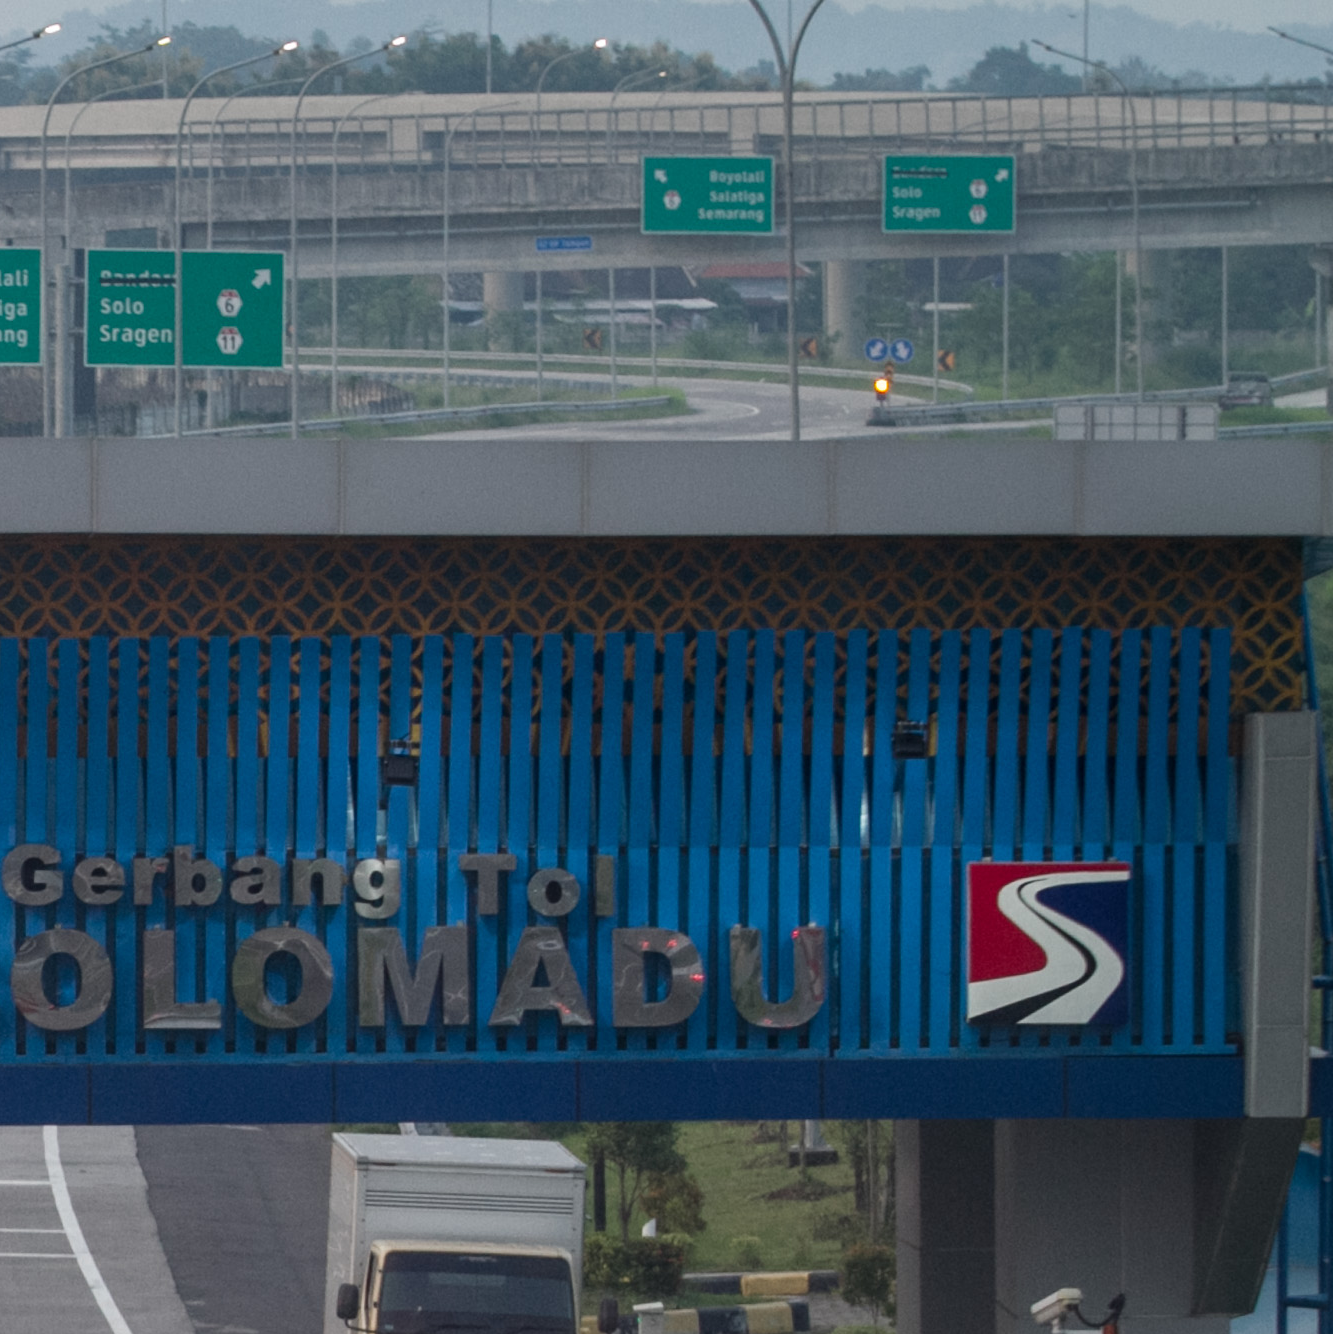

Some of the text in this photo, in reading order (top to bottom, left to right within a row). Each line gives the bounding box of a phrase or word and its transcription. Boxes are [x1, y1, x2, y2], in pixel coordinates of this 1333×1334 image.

[697, 208, 765, 223] Semarang
[892, 205, 941, 222] Sragen
[100, 297, 144, 315] Solo
[224, 298, 234, 313] 6
[99, 324, 173, 348] Sragen
[222, 335, 237, 351] 11
[0, 844, 615, 920] Gerbang Tol
